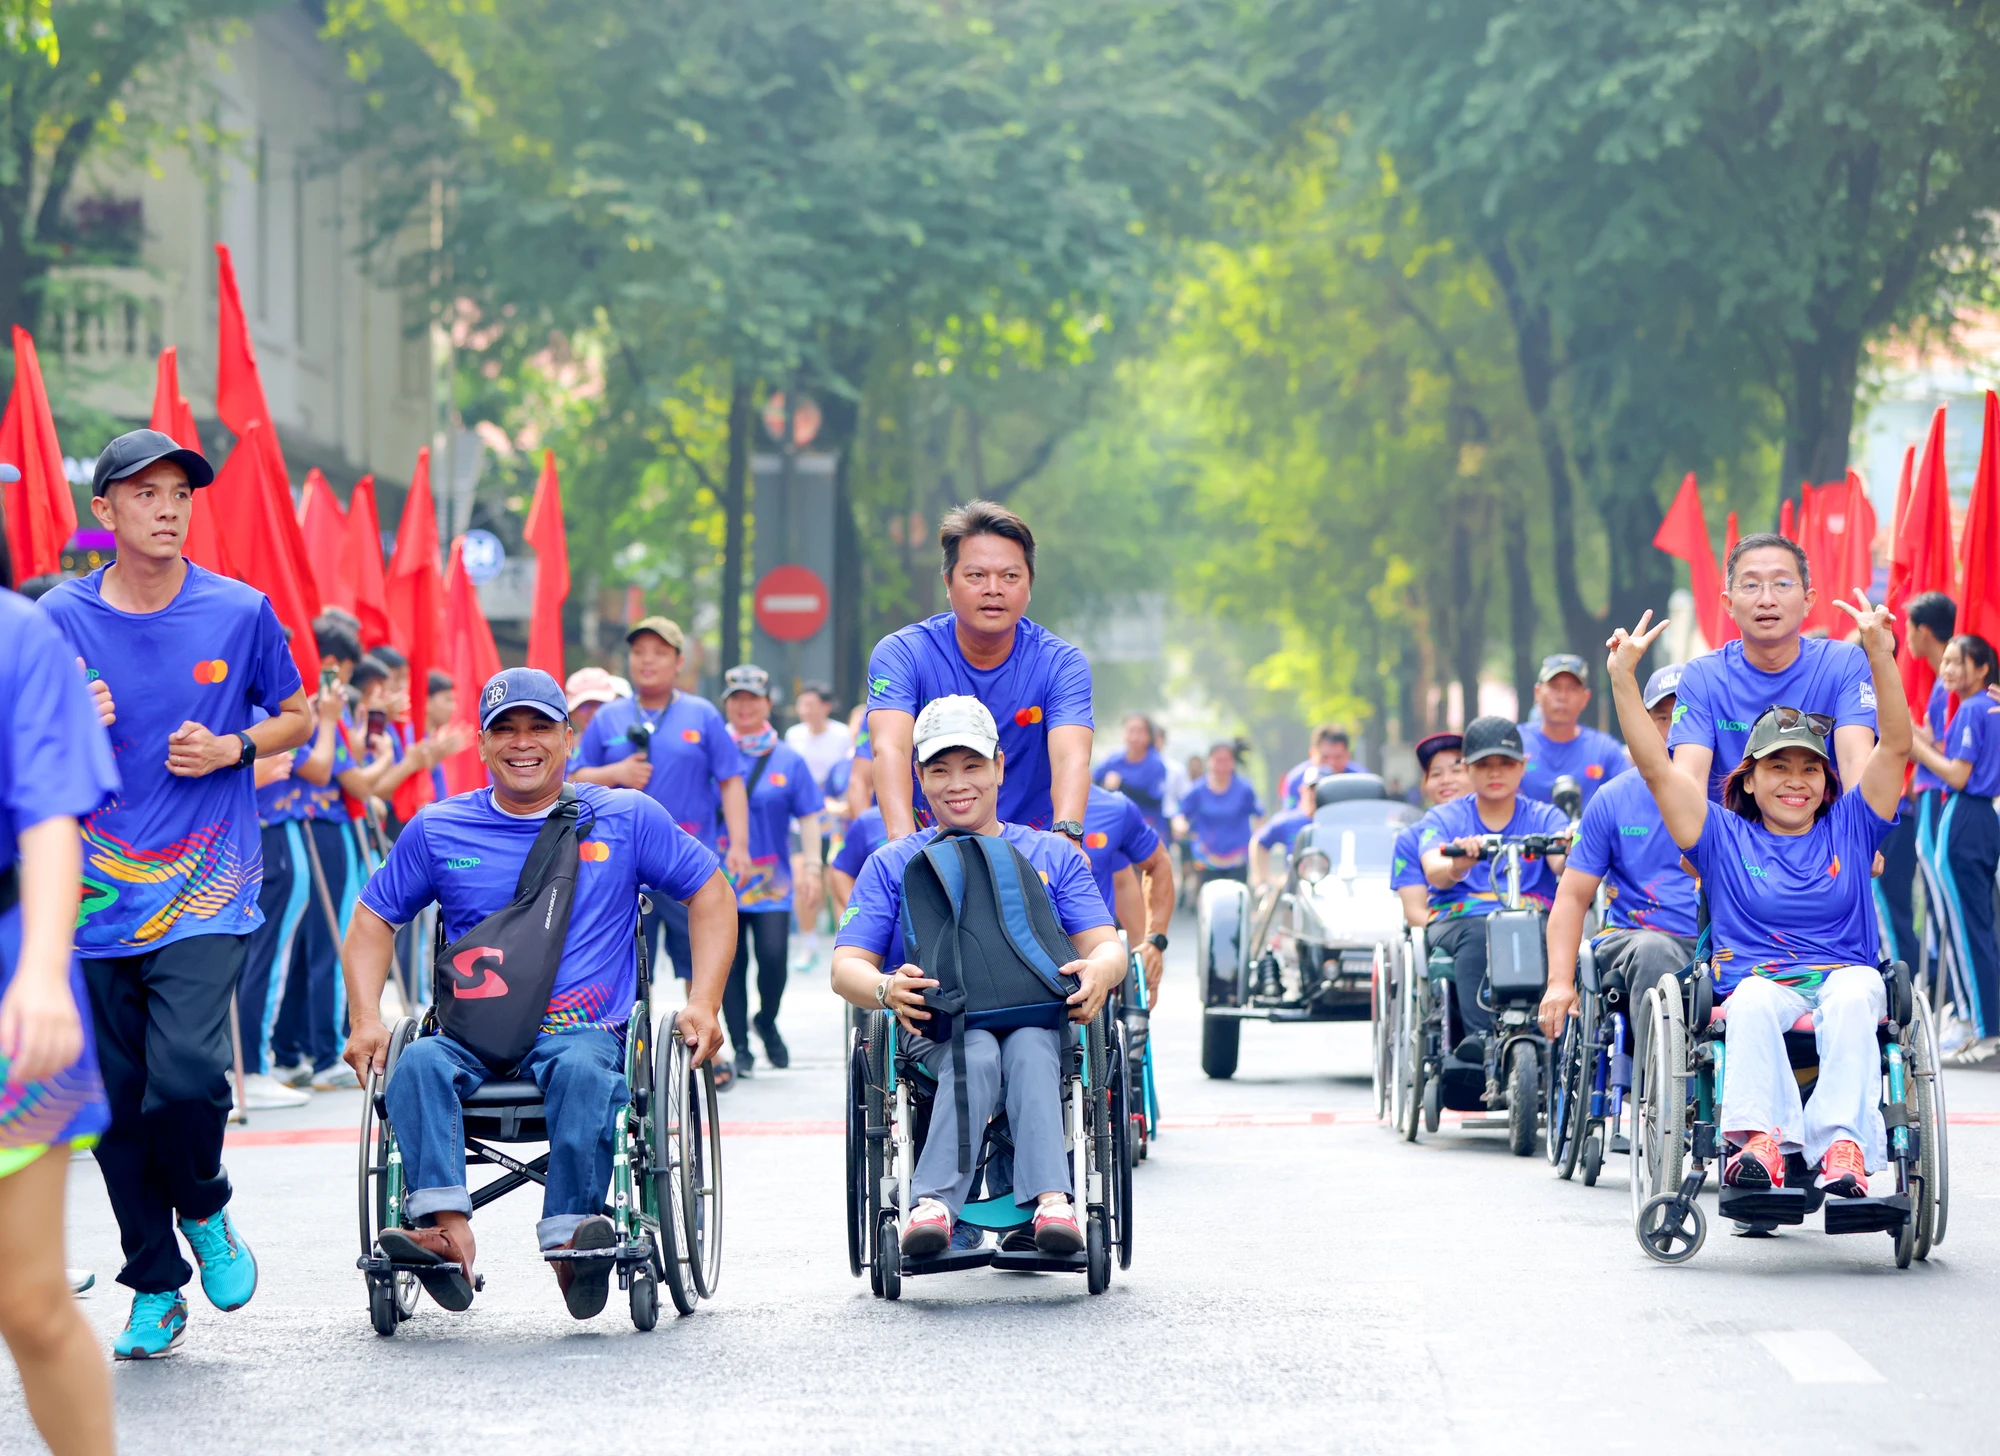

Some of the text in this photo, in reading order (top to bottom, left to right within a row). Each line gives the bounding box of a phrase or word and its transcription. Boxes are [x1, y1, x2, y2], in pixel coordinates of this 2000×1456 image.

[1716, 719, 1749, 731] VLOOP
[1620, 825, 1649, 836] VLOOP
[446, 856, 481, 869] VLOOP
[544, 886, 558, 930] GEARBOX
